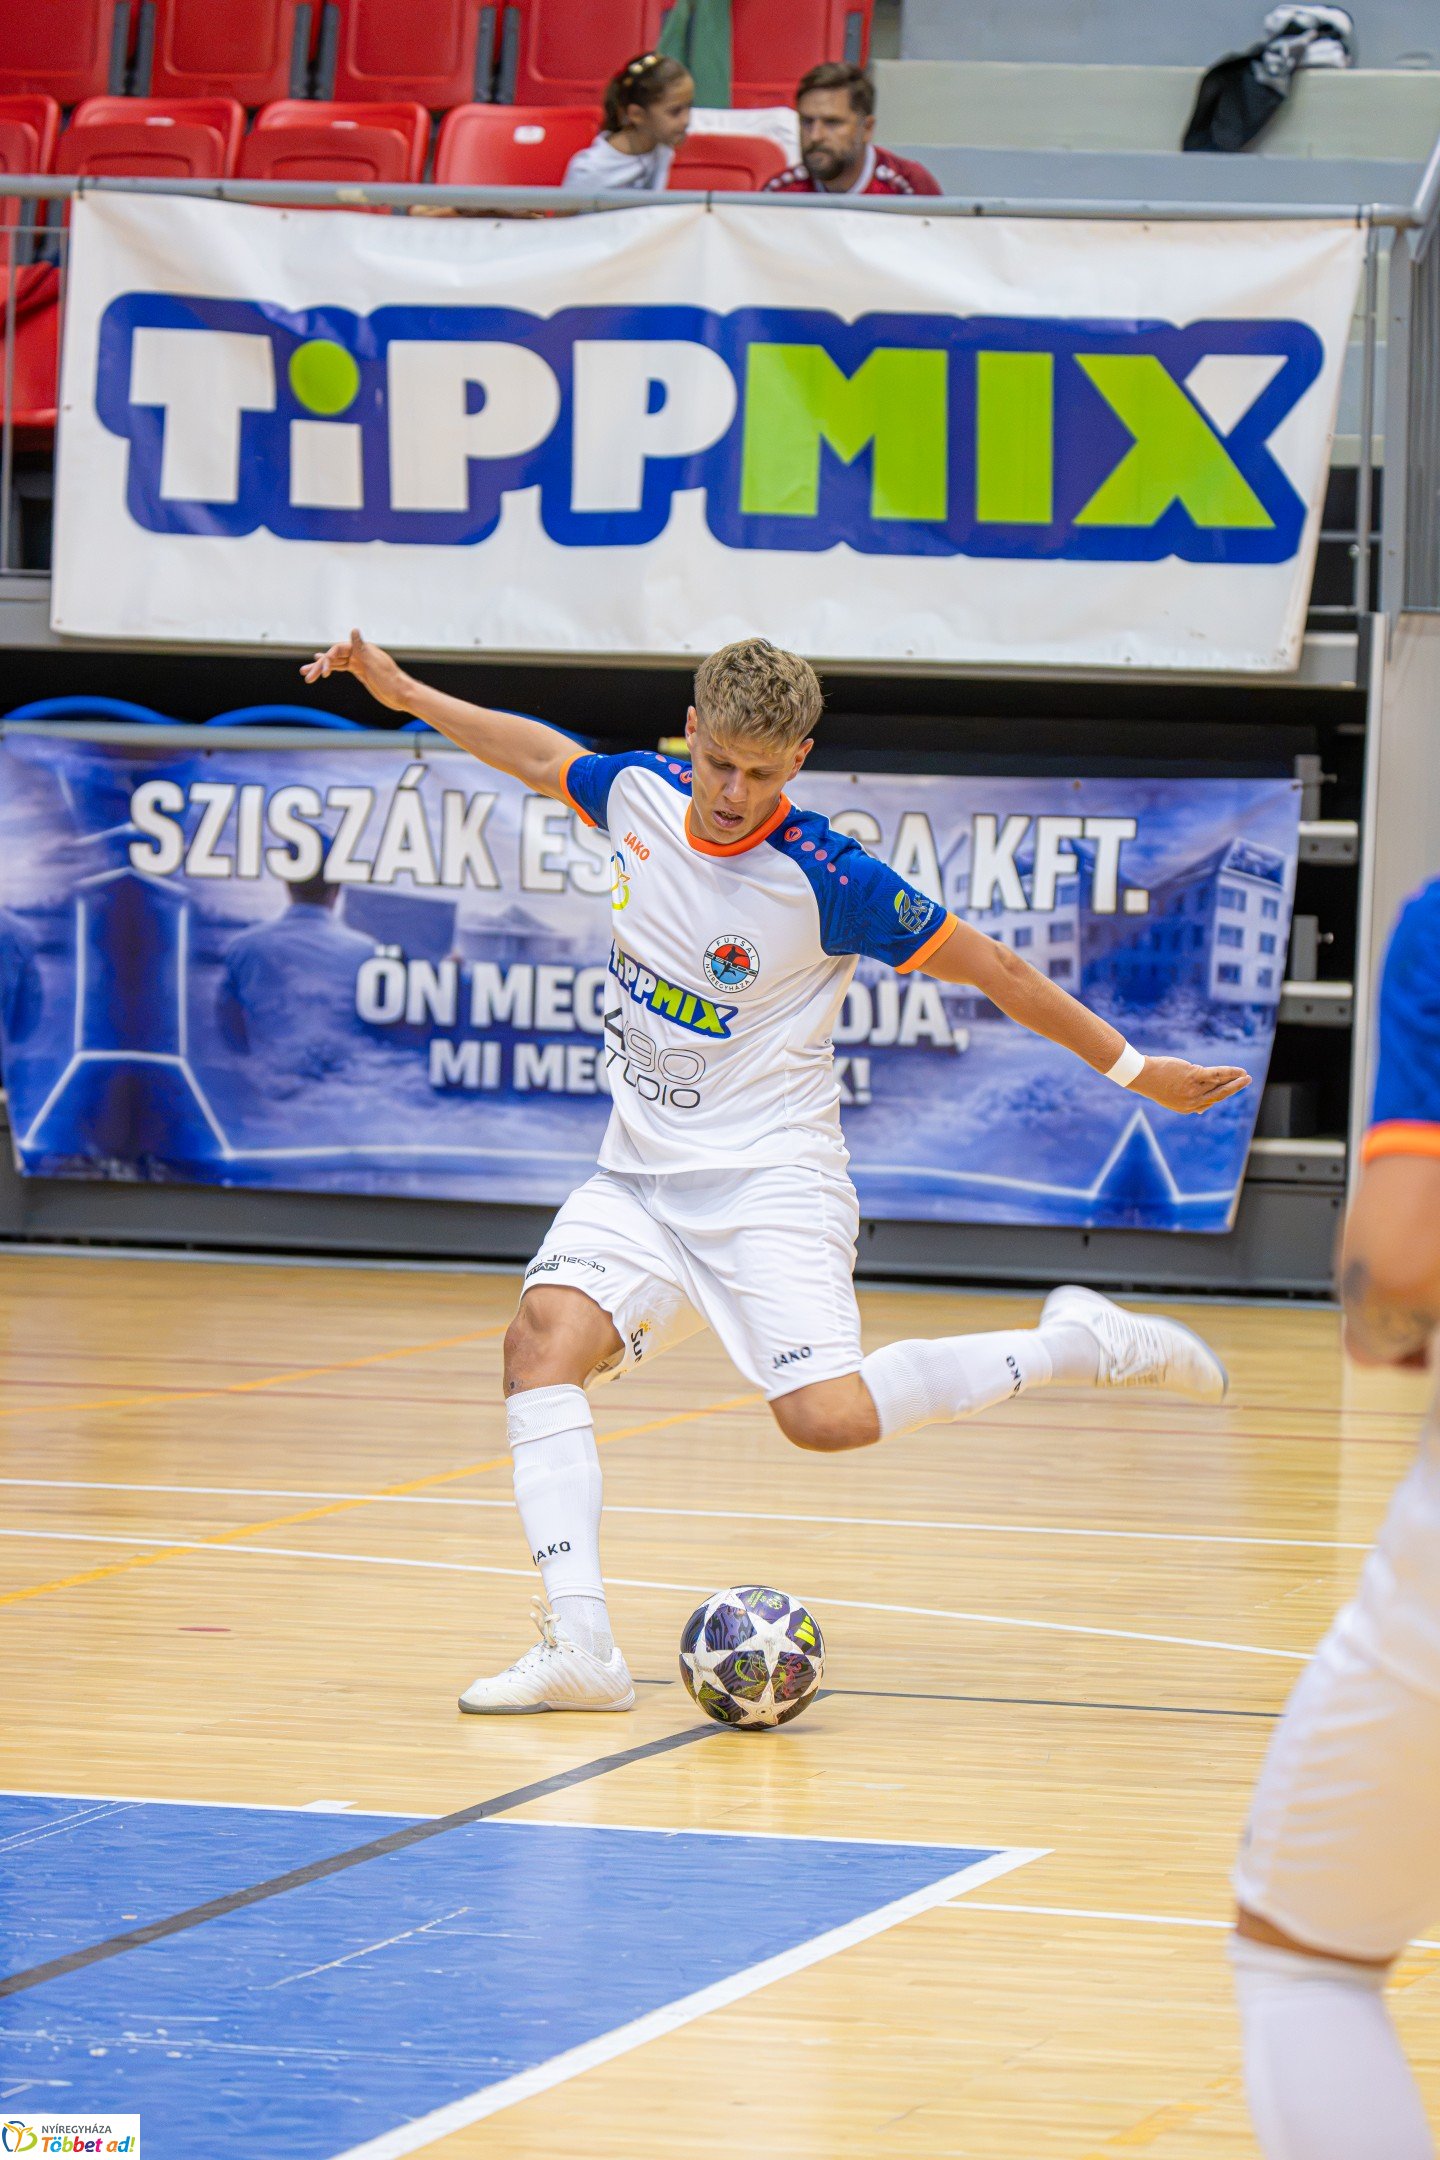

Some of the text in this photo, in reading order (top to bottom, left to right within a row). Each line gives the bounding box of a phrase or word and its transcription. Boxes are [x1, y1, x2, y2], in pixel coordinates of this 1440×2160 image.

[128, 764, 501, 889] SZISZÁK
[970, 812, 1149, 915] KFT.
[624, 832, 651, 861] JAKO
[716, 937, 756, 961] FUTSAL
[356, 943, 458, 1026] ÖN
[430, 1038, 501, 1090] MI
[772, 1346, 813, 1370] JAKO
